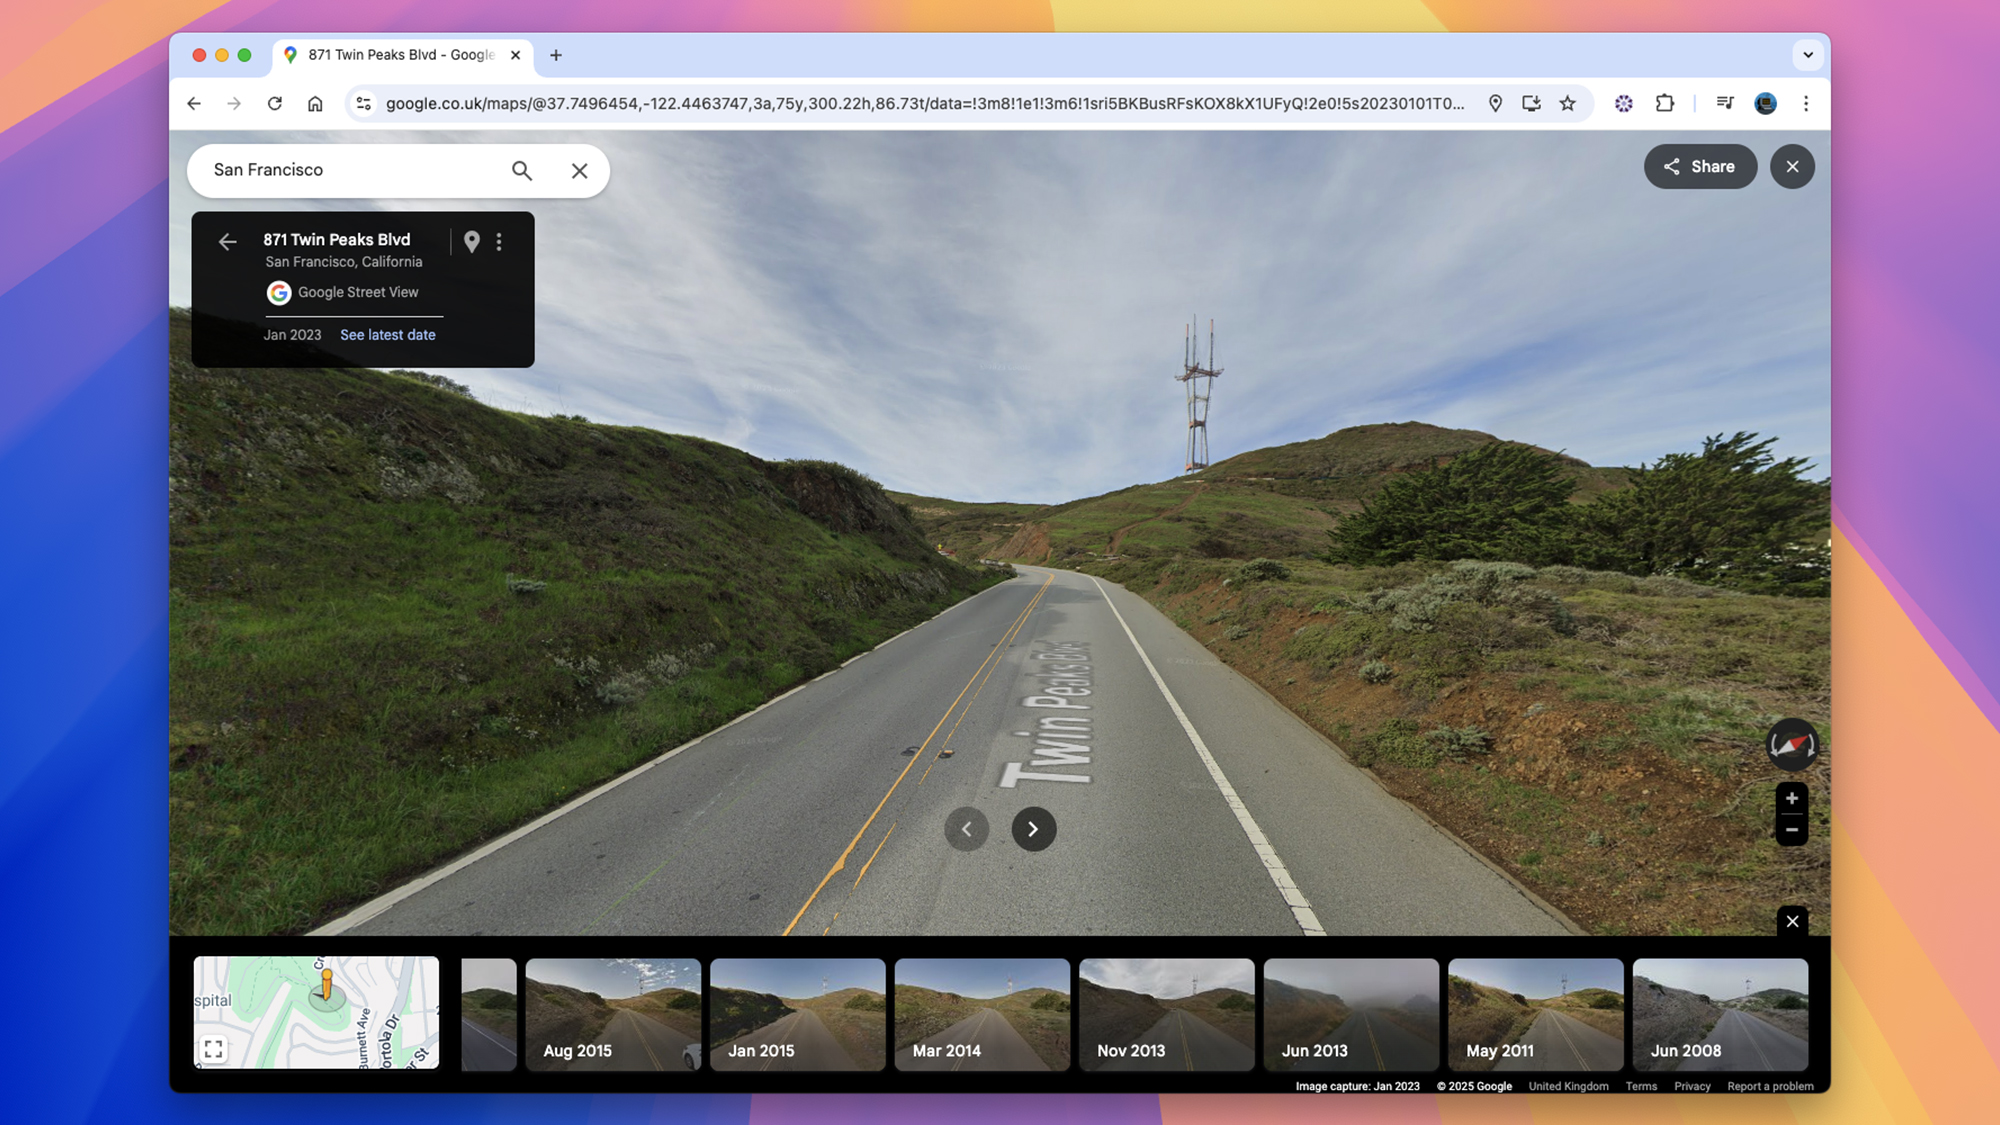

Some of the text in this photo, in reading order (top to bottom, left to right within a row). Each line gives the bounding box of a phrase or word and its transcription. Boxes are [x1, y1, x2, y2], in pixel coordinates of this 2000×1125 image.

[309, 48, 331, 61] 871
[335, 48, 364, 61] Twin
[368, 48, 405, 61] Peaks
[409, 48, 437, 61] Blvd
[450, 48, 497, 63] Google
[214, 161, 324, 177] San Francisco
[1691, 158, 1736, 174] Share
[263, 232, 411, 247] 871 Twin Peaks Blvd
[265, 255, 423, 269] San Francisco, California
[298, 286, 419, 301] Google Street View
[263, 329, 322, 341] Jan 2023
[340, 328, 437, 341] See latest date
[1023, 664, 1092, 710] Peaks
[1000, 716, 1092, 788] Twin
[194, 993, 232, 1009] spital
[356, 1007, 371, 1029] Ave
[378, 1013, 400, 1069] ortola Dr
[413, 1047, 430, 1063] St
[543, 1043, 613, 1061] Aug 2015
[728, 1043, 796, 1058] Jan 2015
[913, 1043, 982, 1058] Mar 2014
[1097, 1043, 1166, 1058] Nov 2013
[1281, 1043, 1349, 1058] Jun 2013
[1466, 1044, 1534, 1061] May 2011
[1651, 1044, 1722, 1058] Jun 2008
[1295, 1080, 1421, 1094] Image capture: Jan 2023
[1448, 1080, 1475, 1092] 2025
[1476, 1080, 1514, 1094] Google
[1528, 1080, 1610, 1094] United Kingdom
[1625, 1081, 1659, 1092] Terms
[1674, 1081, 1712, 1094] Privacy
[1727, 1080, 1815, 1094] Report a problem
